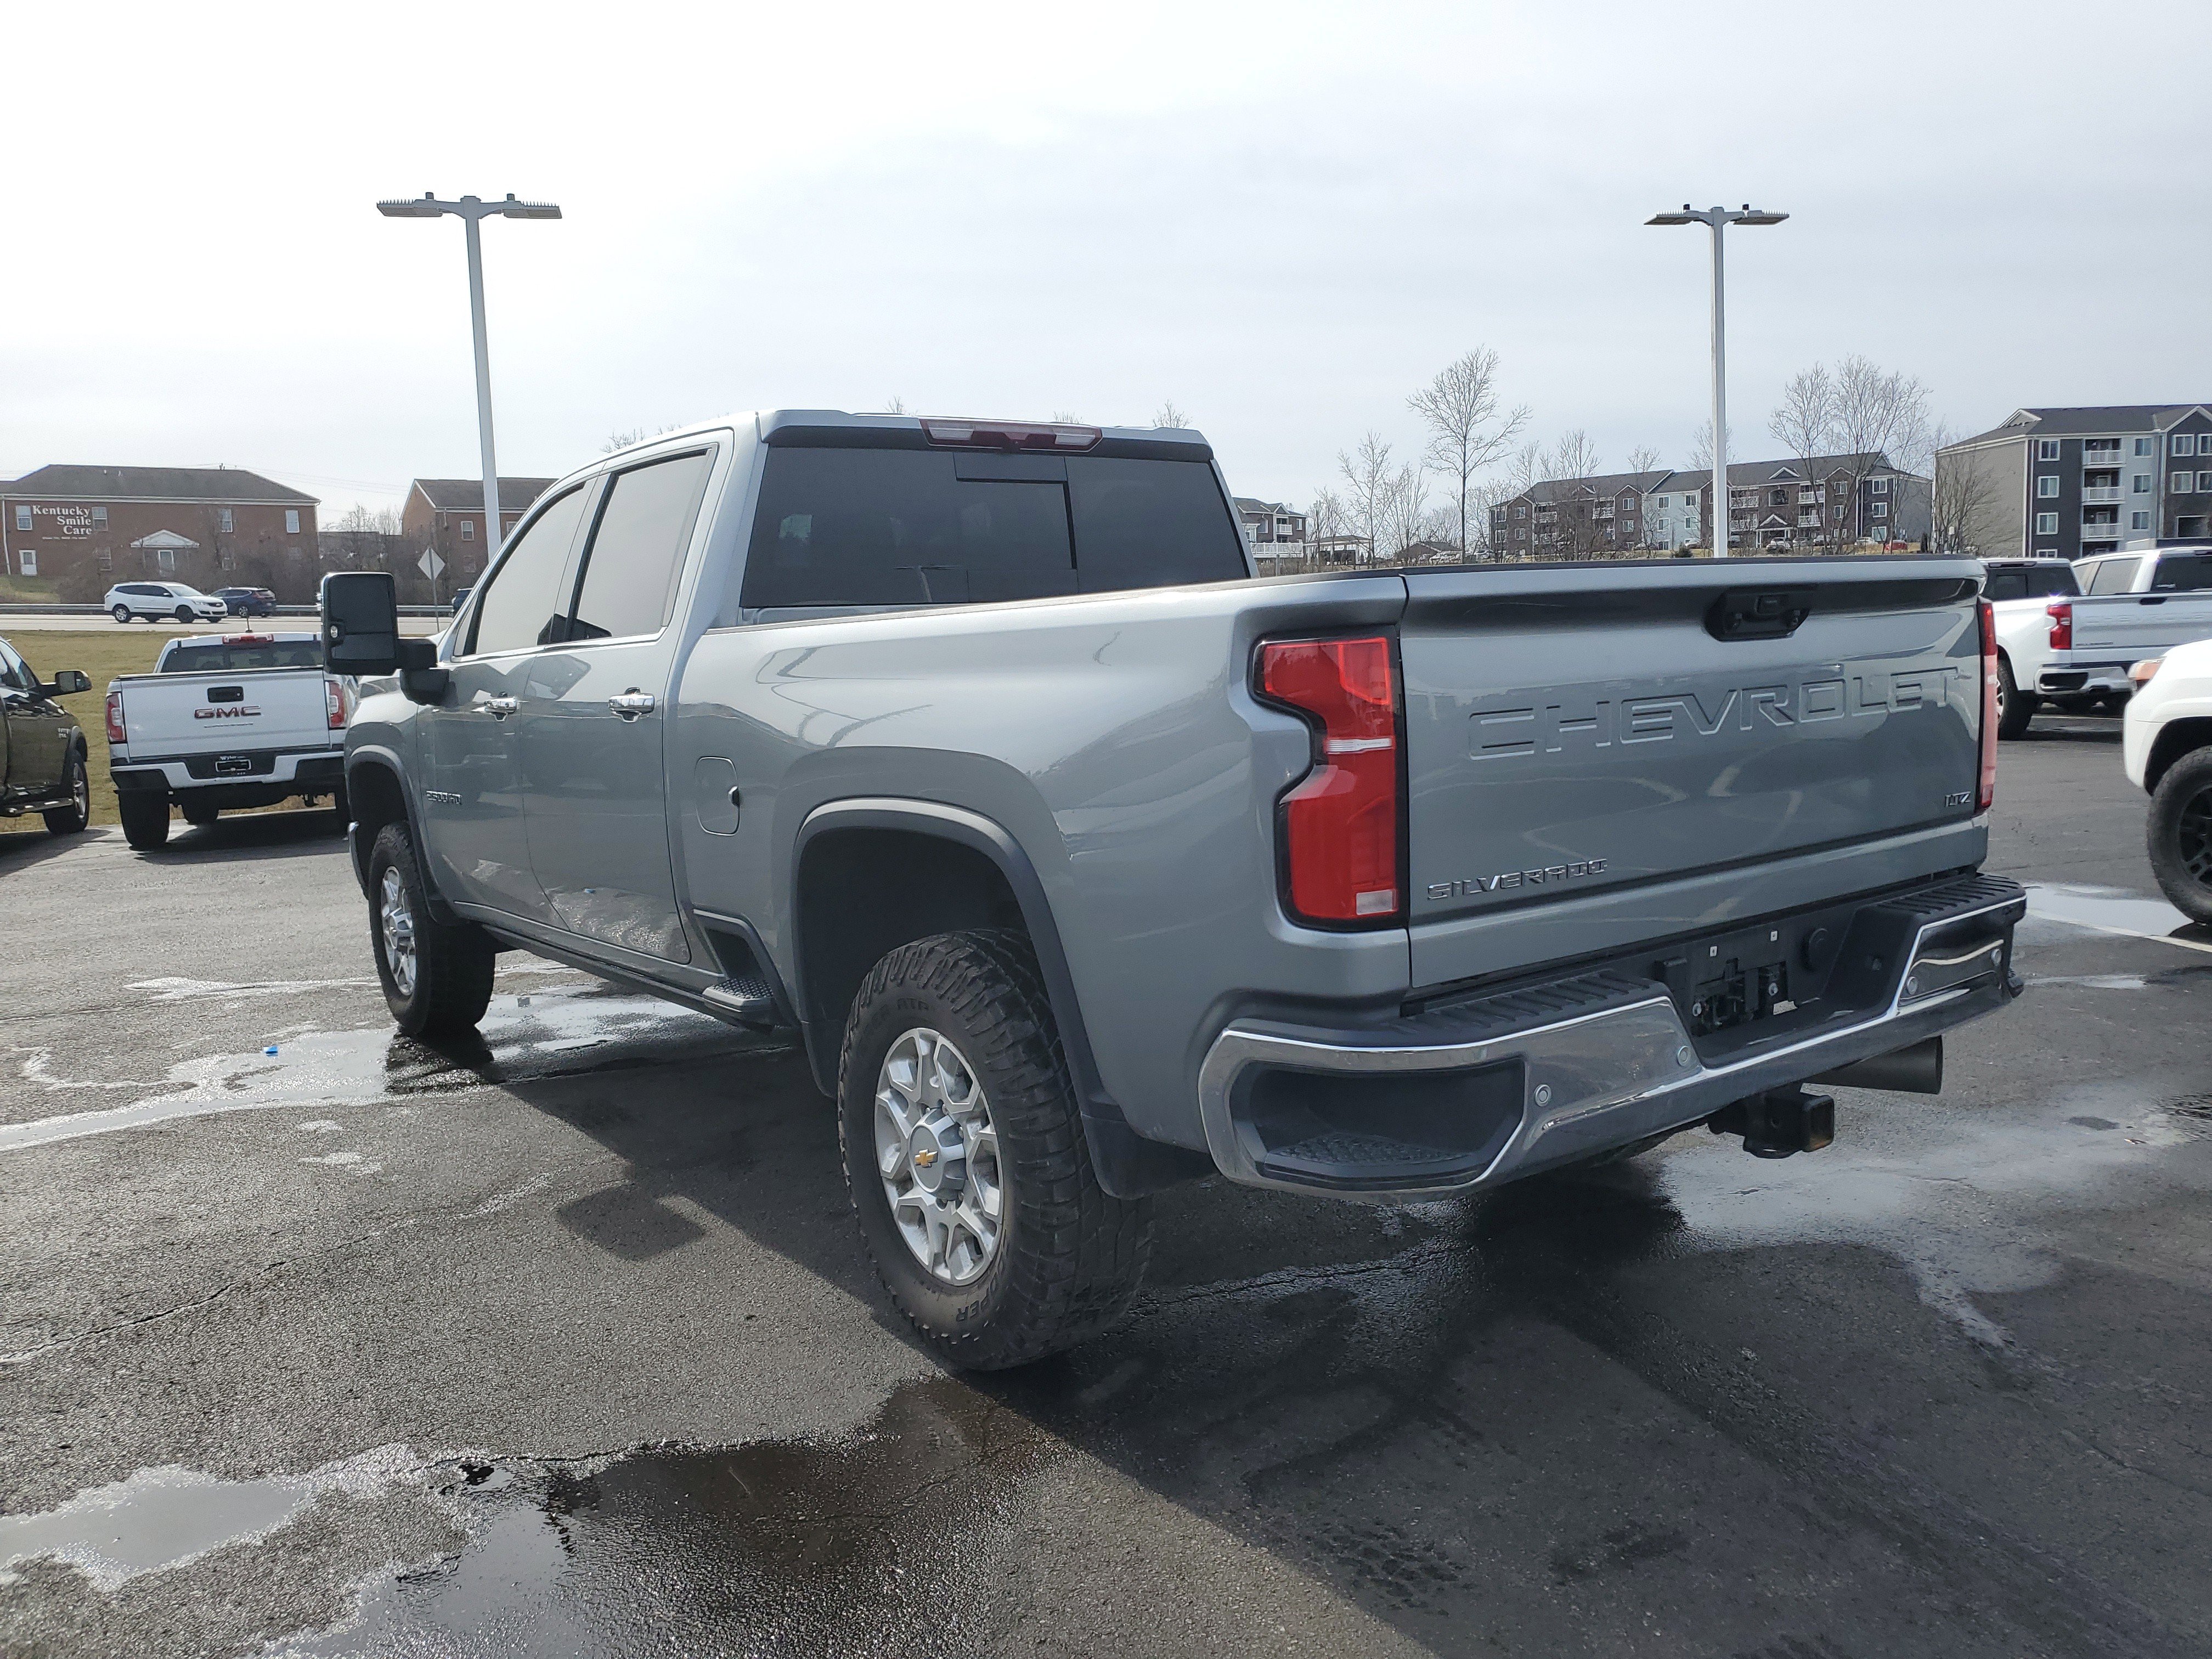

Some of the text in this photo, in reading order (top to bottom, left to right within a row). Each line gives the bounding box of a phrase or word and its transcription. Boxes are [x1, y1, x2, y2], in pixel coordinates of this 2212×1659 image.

[32, 505, 90, 517] Kentucky
[57, 516, 92, 525] Smile
[63, 526, 92, 535] Care
[194, 705, 261, 719] GMC
[1469, 665, 1958, 760] CHEVROLET
[1944, 791, 1971, 808] LTZ
[1427, 858, 1608, 900] SILVERADO
